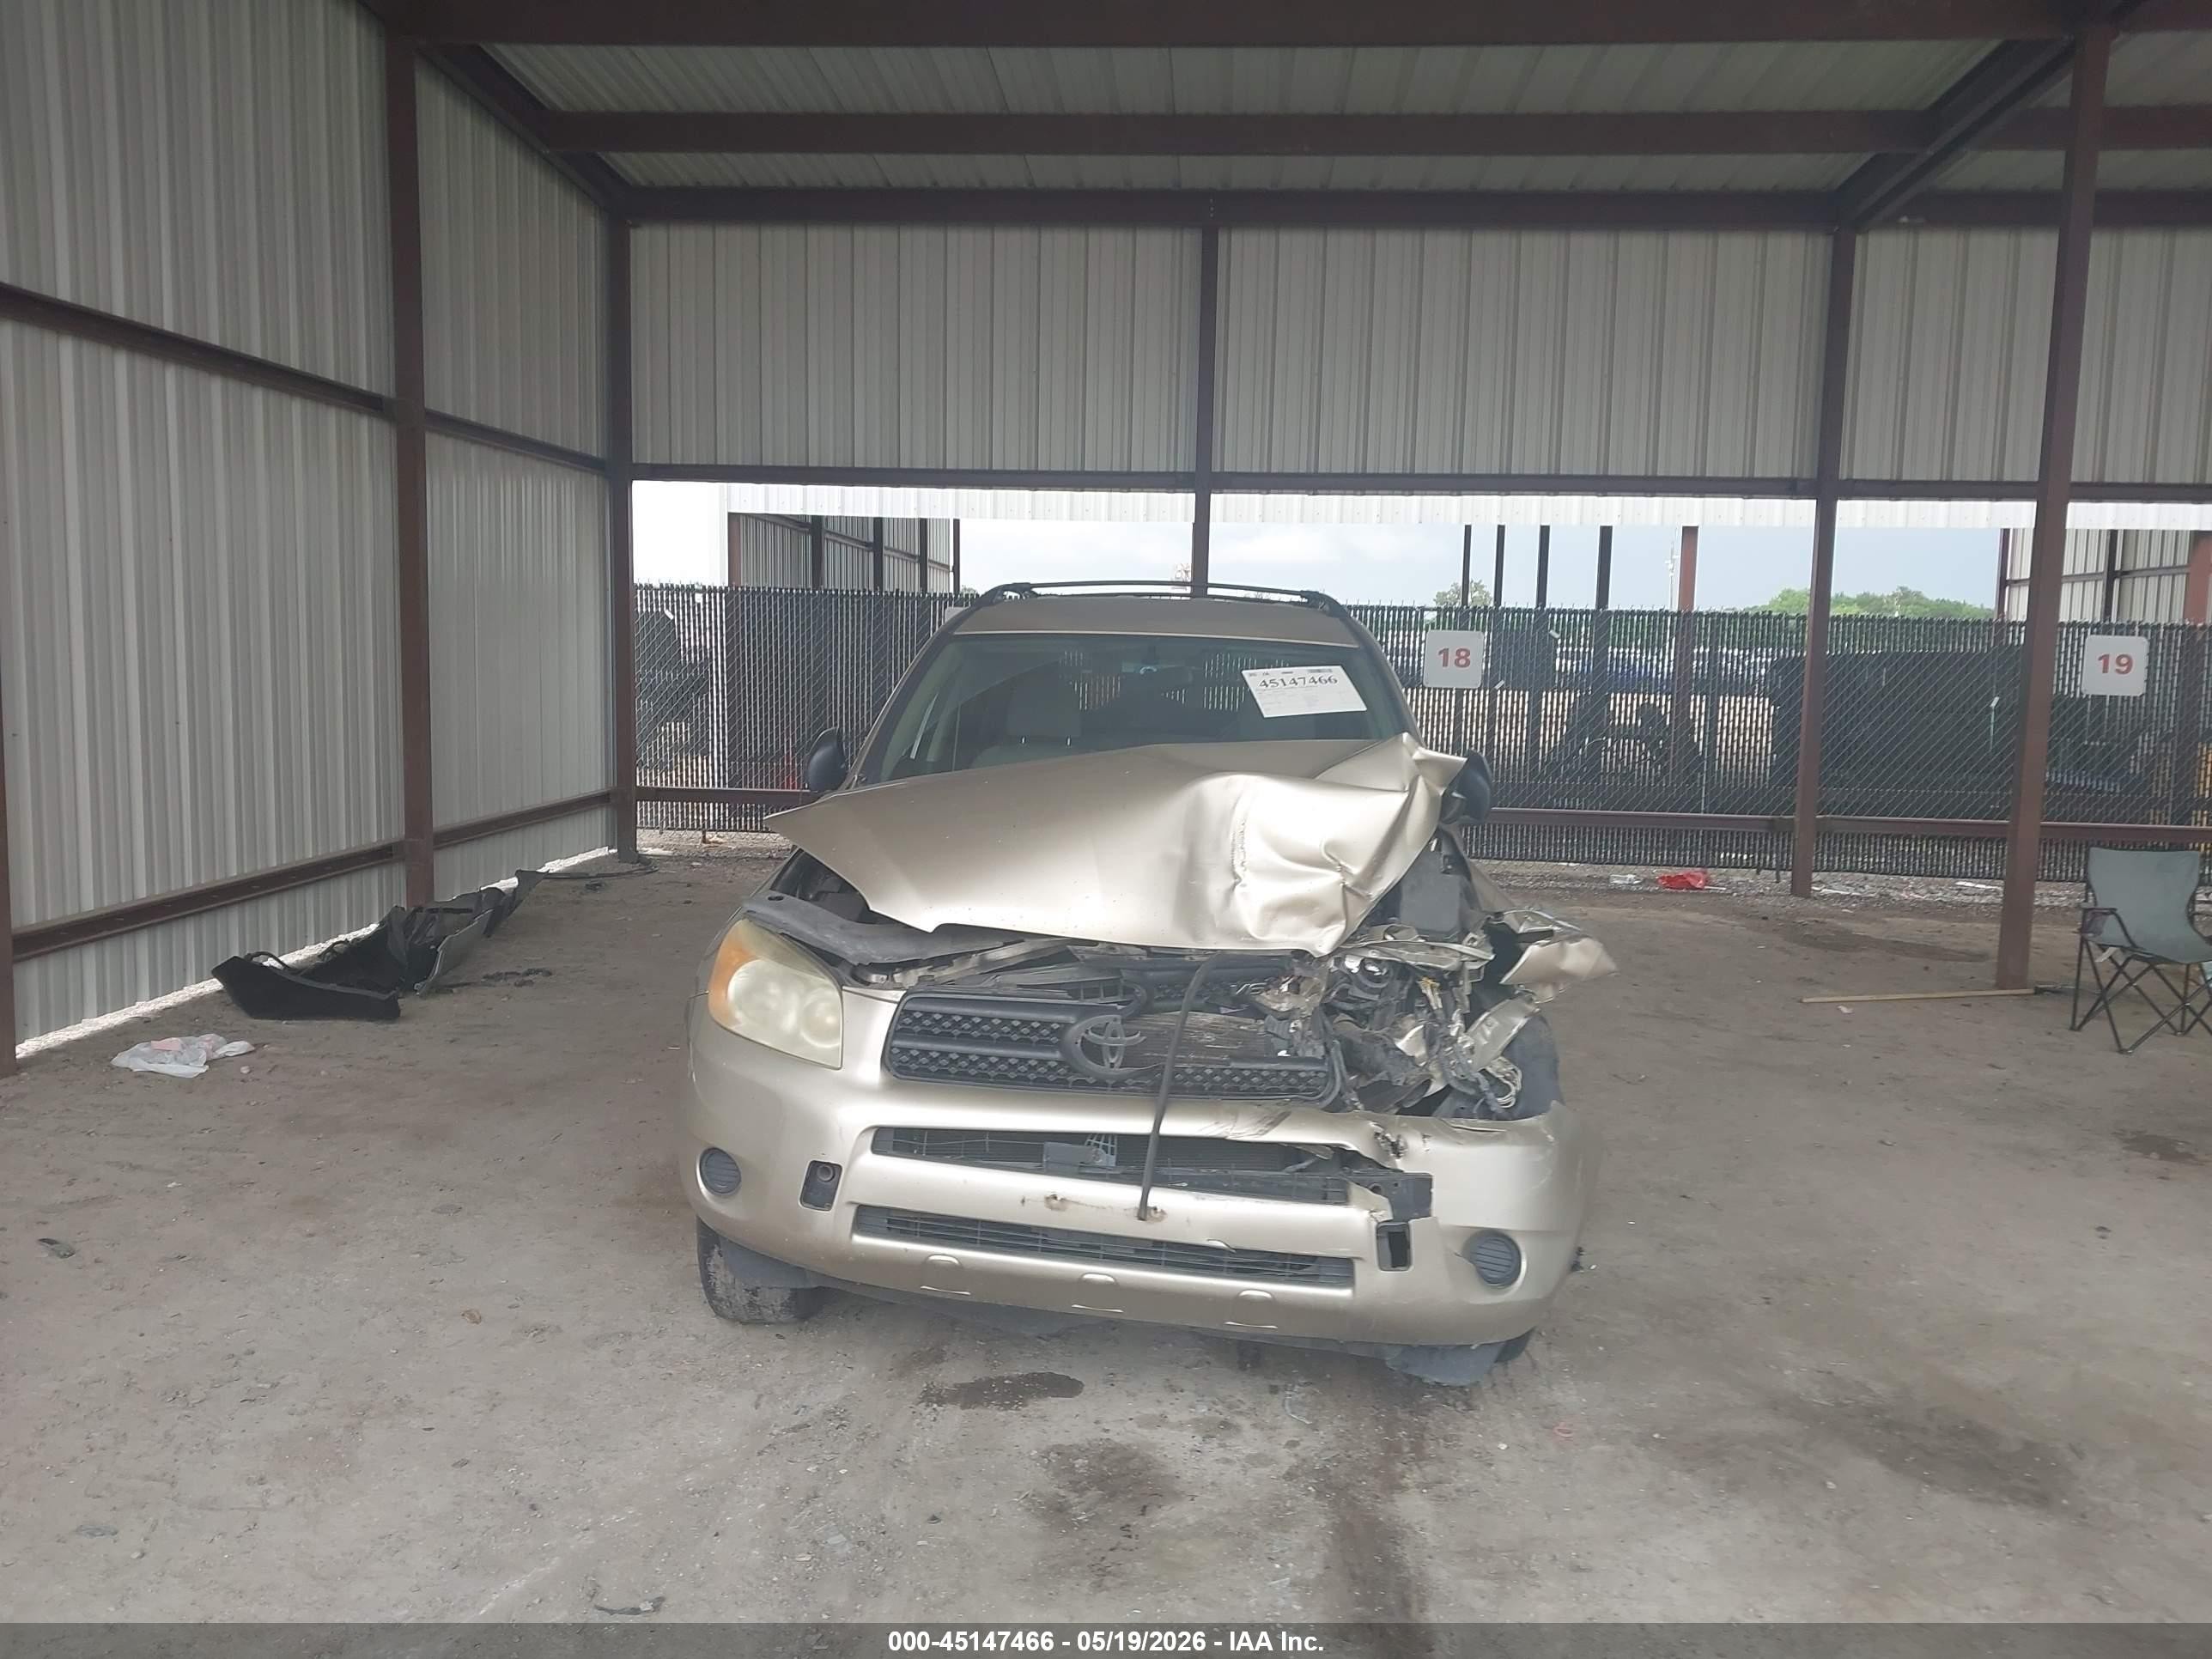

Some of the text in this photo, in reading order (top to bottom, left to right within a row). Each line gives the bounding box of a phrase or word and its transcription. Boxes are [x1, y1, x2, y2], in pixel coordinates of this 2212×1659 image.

[1437, 647, 1471, 668] 18
[2097, 653, 2134, 675] 19
[1259, 675, 1338, 688] 45147466
